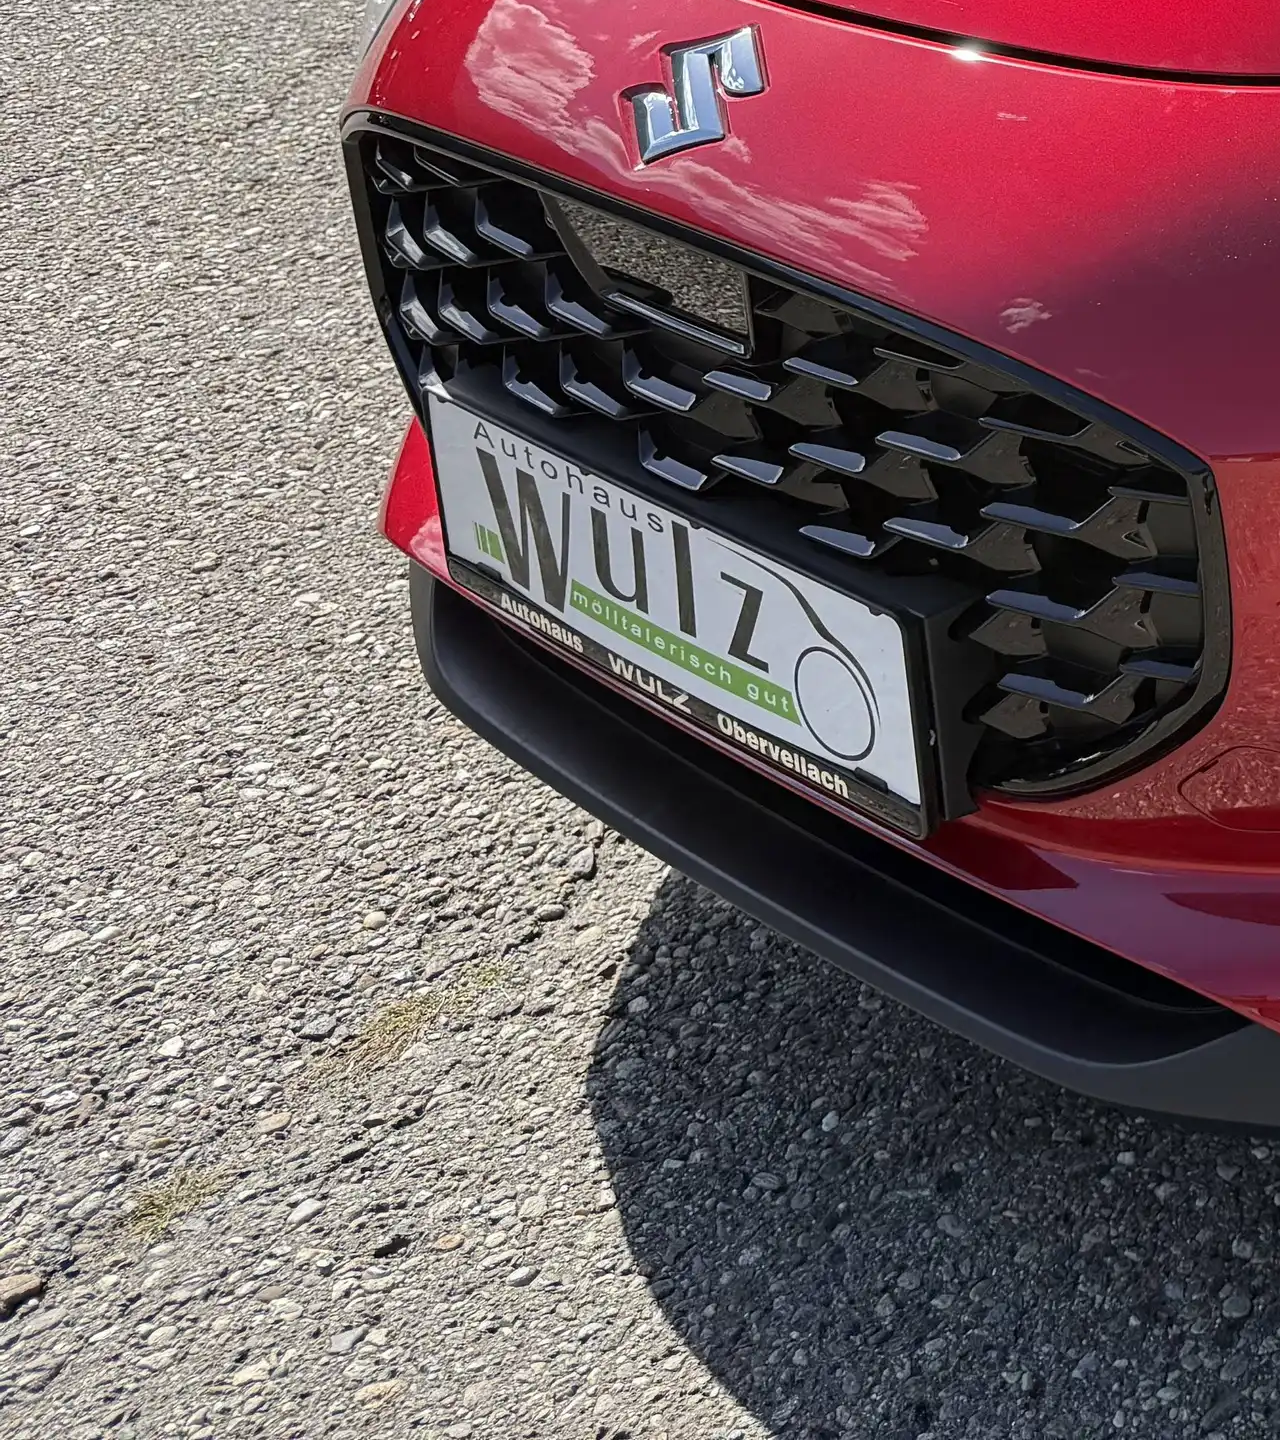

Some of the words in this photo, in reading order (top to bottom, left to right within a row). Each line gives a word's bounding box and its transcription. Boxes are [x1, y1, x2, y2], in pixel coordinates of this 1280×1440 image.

[473, 421, 664, 533] Autohaus
[476, 446, 770, 673] Wulz
[500, 593, 584, 653] Autohaus
[608, 652, 692, 715] WULZ
[717, 713, 849, 798] Obervellach
[573, 589, 732, 685] mölltalerisch
[746, 683, 789, 712] gut
